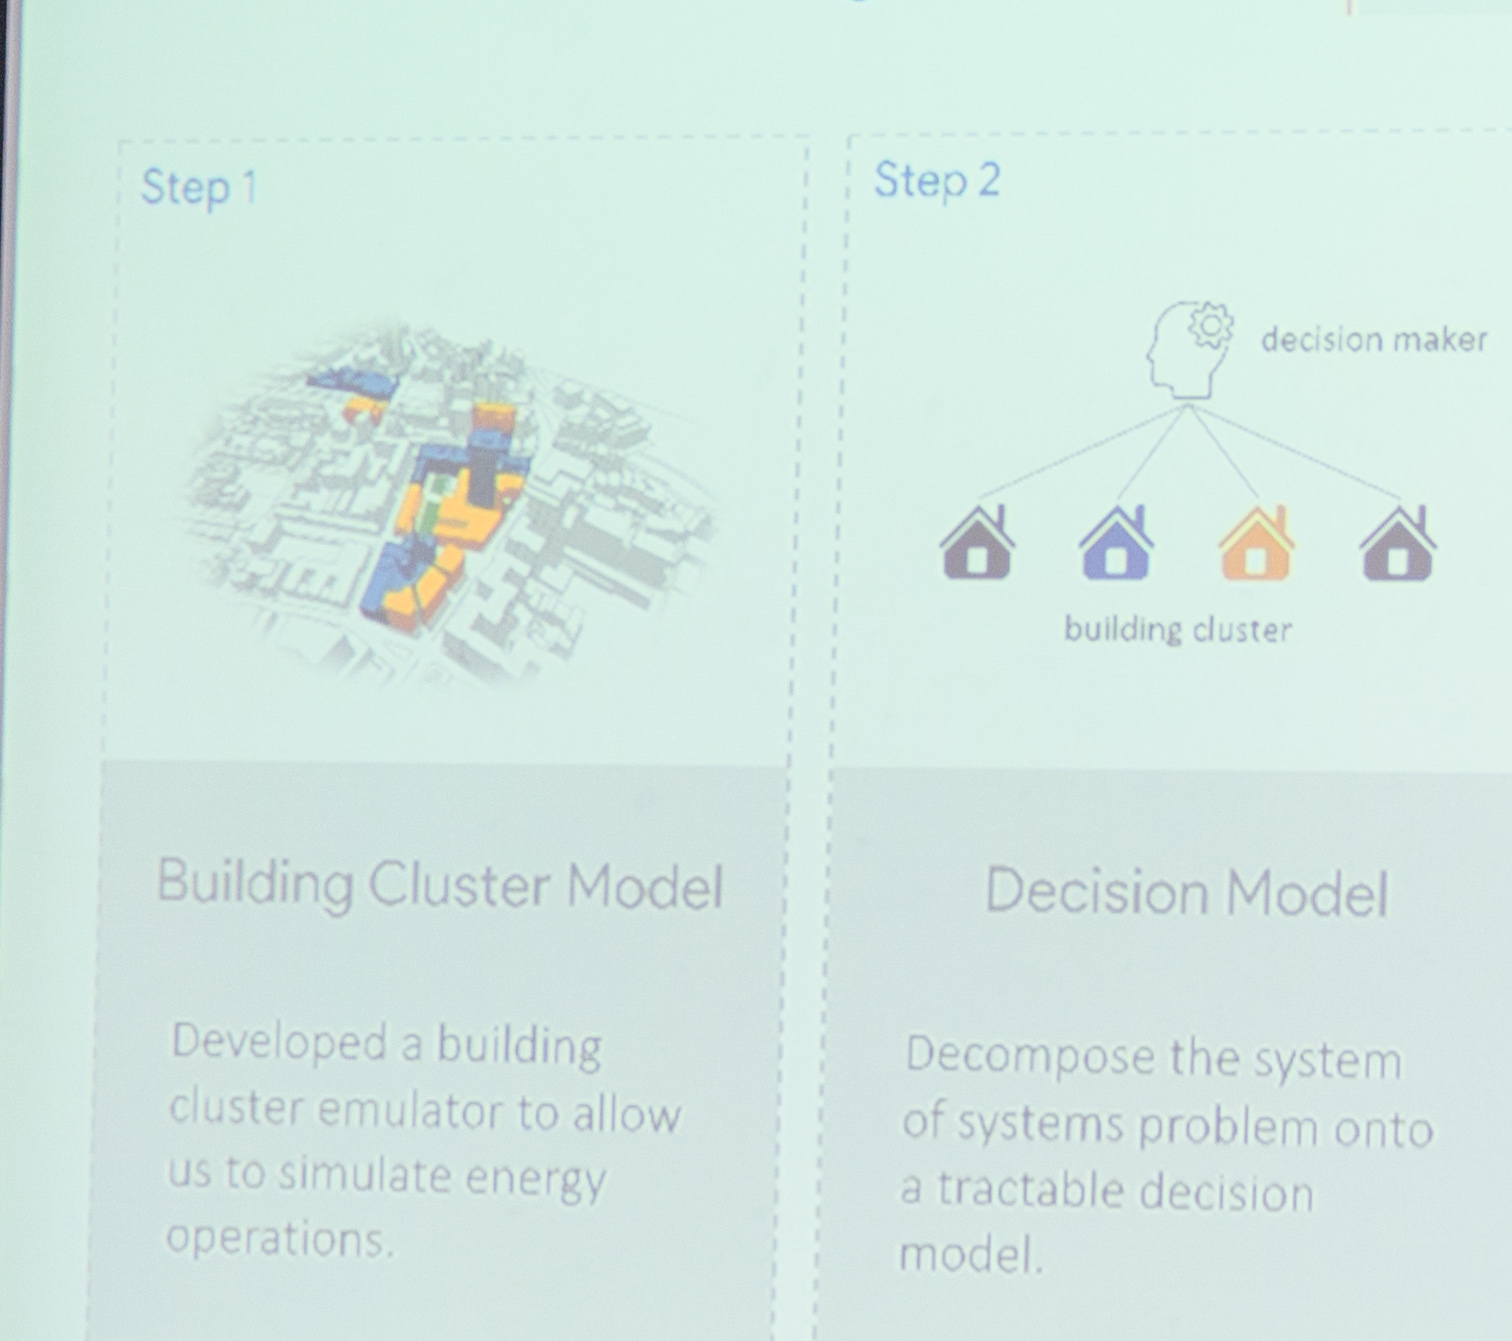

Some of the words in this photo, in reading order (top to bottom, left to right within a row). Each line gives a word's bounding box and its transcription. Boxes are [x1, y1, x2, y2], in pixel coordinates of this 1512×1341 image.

[141, 166, 230, 214] Step
[243, 166, 257, 203] 1
[874, 159, 968, 205] Step
[978, 160, 1001, 197] 2
[1261, 325, 1384, 353] decision
[1393, 325, 1488, 353] maker
[1064, 614, 1183, 648] building
[1193, 614, 1293, 644] cluster
[158, 856, 354, 919] Building
[369, 859, 552, 909] Cluster
[568, 862, 723, 911] Model
[987, 864, 1209, 915] Decision
[1228, 868, 1388, 918] Model
[173, 1021, 386, 1068] Developed
[403, 1033, 422, 1062] a
[438, 1022, 602, 1076] building
[907, 1034, 1155, 1082] Decompose
[1171, 1035, 1240, 1077] the
[1256, 1043, 1401, 1087] system
[169, 1086, 305, 1126] cluster
[318, 1090, 503, 1130] emulator
[518, 1096, 559, 1132] to
[573, 1092, 681, 1134] allow
[903, 1097, 946, 1139] of
[960, 1105, 1124, 1147] systems
[1140, 1104, 1318, 1151] problem
[1335, 1113, 1434, 1149] onto
[169, 1159, 211, 1188] us
[226, 1156, 266, 1189] to
[279, 1155, 452, 1194] simulate
[466, 1165, 607, 1207] energy
[902, 1174, 922, 1204] a
[939, 1170, 1125, 1209] tractable
[1140, 1171, 1313, 1212] decision
[165, 1218, 396, 1261] operations.
[900, 1233, 1042, 1274] model.
